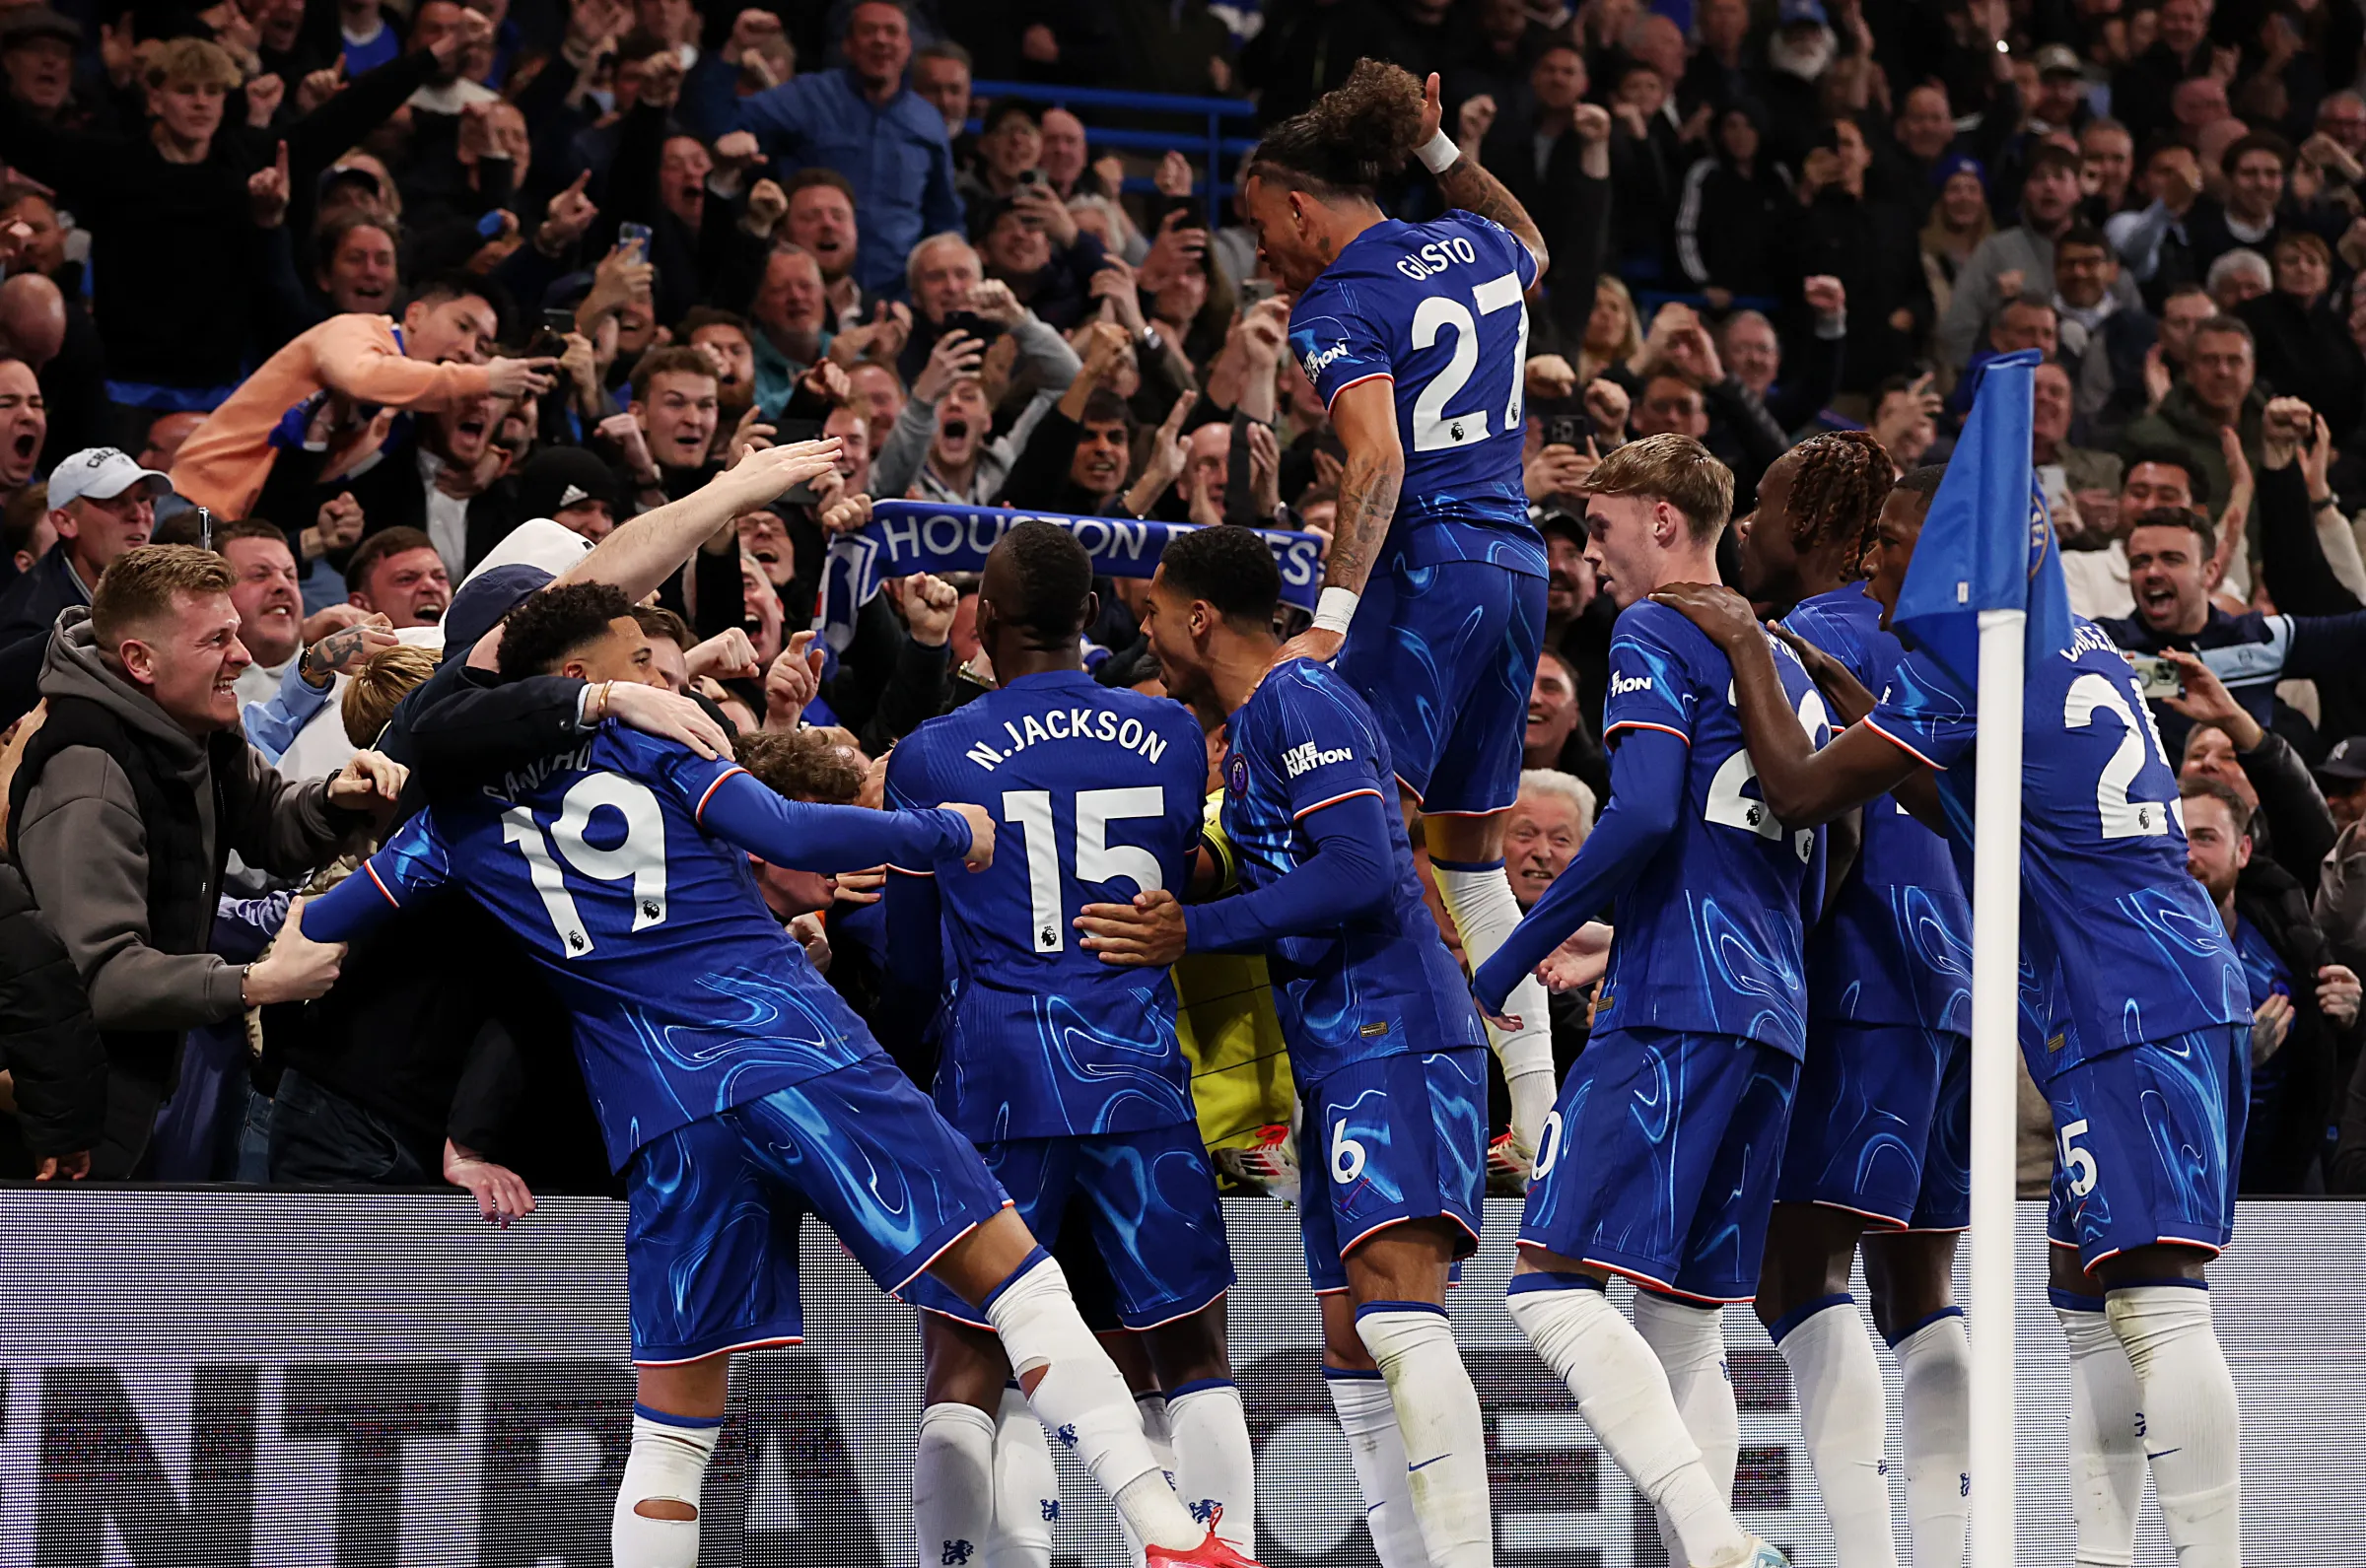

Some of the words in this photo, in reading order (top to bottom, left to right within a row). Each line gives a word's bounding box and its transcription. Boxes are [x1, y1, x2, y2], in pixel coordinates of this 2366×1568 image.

[1396, 237, 1476, 281] GUSTO
[1412, 270, 1529, 451] 27
[880, 514, 1148, 563] HOUON
[966, 709, 1167, 772] N.JACKSON
[1282, 741, 1318, 767] LIVE
[1287, 747, 1353, 779] NATION
[501, 772, 666, 959] 19
[1002, 785, 1164, 953] 15
[1332, 1118, 1366, 1184] 6
[1531, 1110, 1563, 1181] 0
[2055, 1118, 2097, 1202] 5
[0, 1362, 1080, 1568] NTRA
